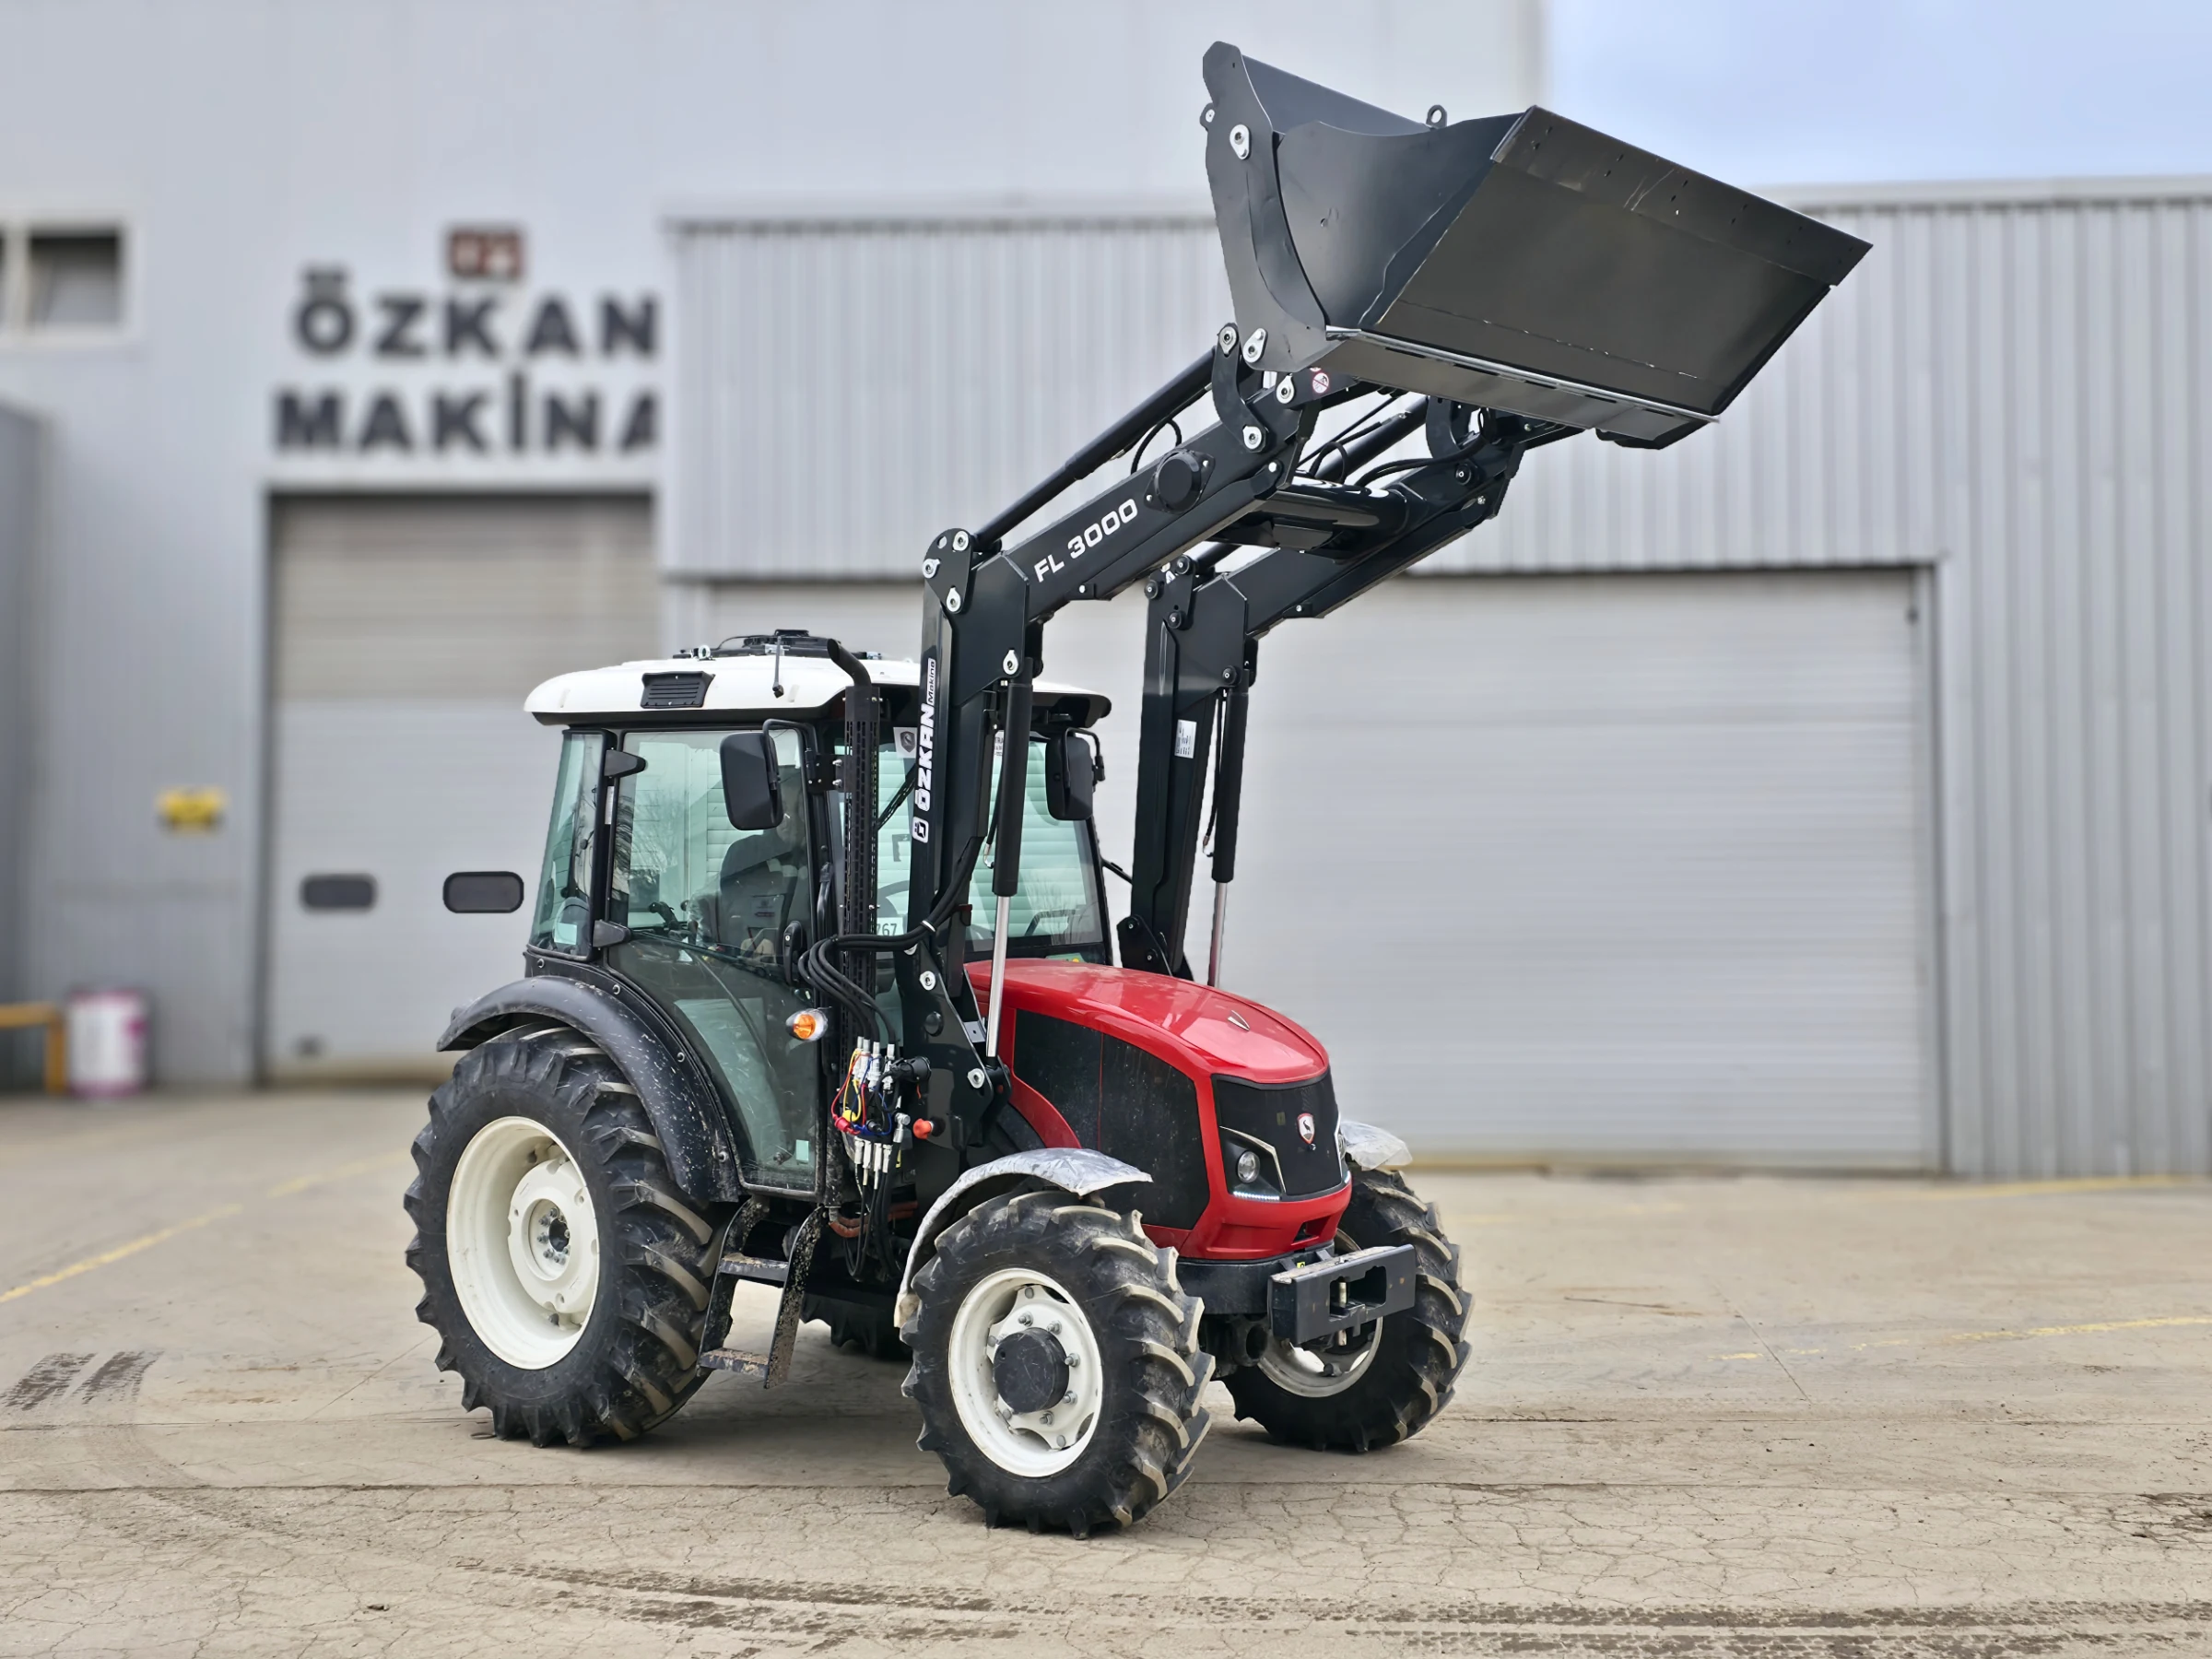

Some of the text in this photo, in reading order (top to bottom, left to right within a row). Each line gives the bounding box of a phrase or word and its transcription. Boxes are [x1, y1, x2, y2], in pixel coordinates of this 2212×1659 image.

[293, 265, 660, 360] ÖZKAN
[274, 371, 660, 453] MAKİNA
[1033, 499, 1138, 582] FL 3000
[915, 660, 935, 812] ÖZKAN Makina
